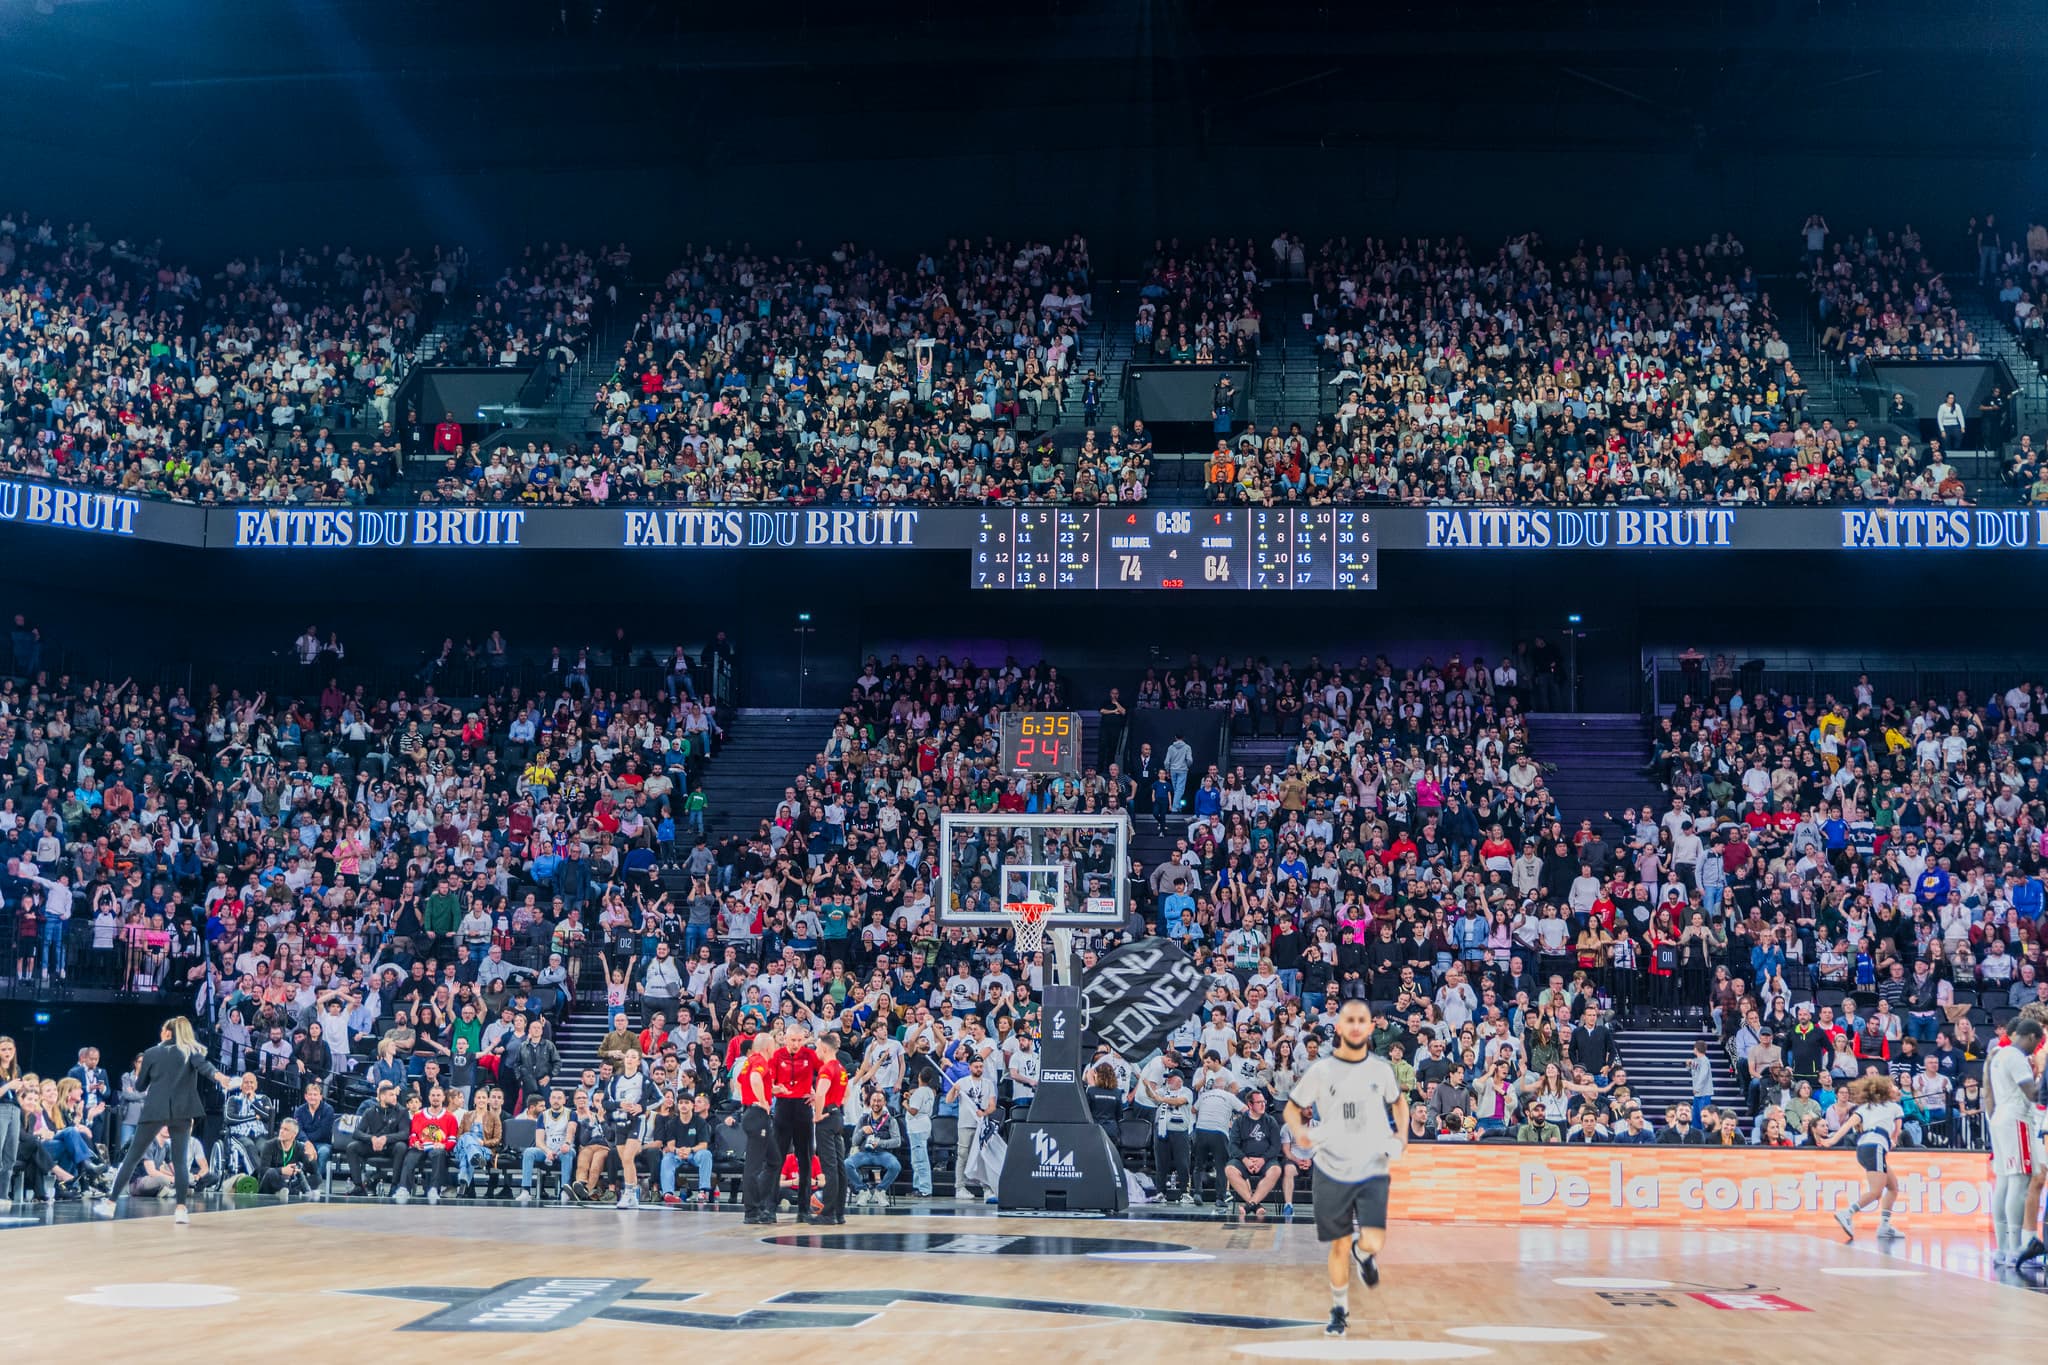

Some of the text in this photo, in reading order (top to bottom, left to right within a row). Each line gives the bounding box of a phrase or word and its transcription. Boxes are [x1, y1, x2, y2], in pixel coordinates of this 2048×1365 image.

[27, 485, 139, 533] BRUIT
[980, 513, 987, 523] 1
[1021, 513, 1047, 523] 8 5
[1060, 513, 1090, 523] 21 7
[1126, 514, 1136, 525] 4
[1258, 513, 1285, 523] 3 2
[1300, 513, 1330, 523] 8 10
[1339, 513, 1370, 523] 27 8
[237, 510, 525, 547] FAITES DU BRUIT
[624, 510, 918, 546] FAITES DU BRUIT
[1426, 511, 1735, 547] FAITES DU BRUIT
[1842, 510, 1970, 547] FAITES
[1976, 511, 2030, 547] DU
[980, 533, 1006, 542] 3 8
[1018, 533, 1031, 542] 11
[1060, 533, 1090, 542] 23 7
[1258, 533, 1285, 542] 4 8
[1297, 533, 1327, 542] 11 4
[1339, 533, 1370, 542] 30 6
[979, 553, 1009, 563] 6 12
[1017, 553, 1049, 563] 12 11
[1060, 553, 1089, 563] 28 8
[1169, 550, 1178, 559] 4
[1258, 553, 1288, 563] 5 10
[1297, 553, 1311, 563] 16
[1339, 553, 1369, 563] 34 9
[1120, 556, 1142, 581] 74
[1205, 556, 1230, 581] 64
[979, 573, 1005, 582] 7 8
[1017, 573, 1046, 582] 13 8
[1059, 573, 1074, 582] 34
[1258, 573, 1285, 582] 7 3
[1297, 573, 1311, 582] 17
[1339, 573, 1370, 582] 90 4
[1022, 716, 1069, 736] 6:35
[1016, 738, 1059, 766] 24
[620, 938, 632, 948] 012
[1662, 952, 1672, 962] 011
[1098, 955, 1203, 1054] GONES
[1044, 1072, 1072, 1080] Betclic
[1520, 1163, 1590, 1208] De
[1610, 1160, 1660, 1208] la
